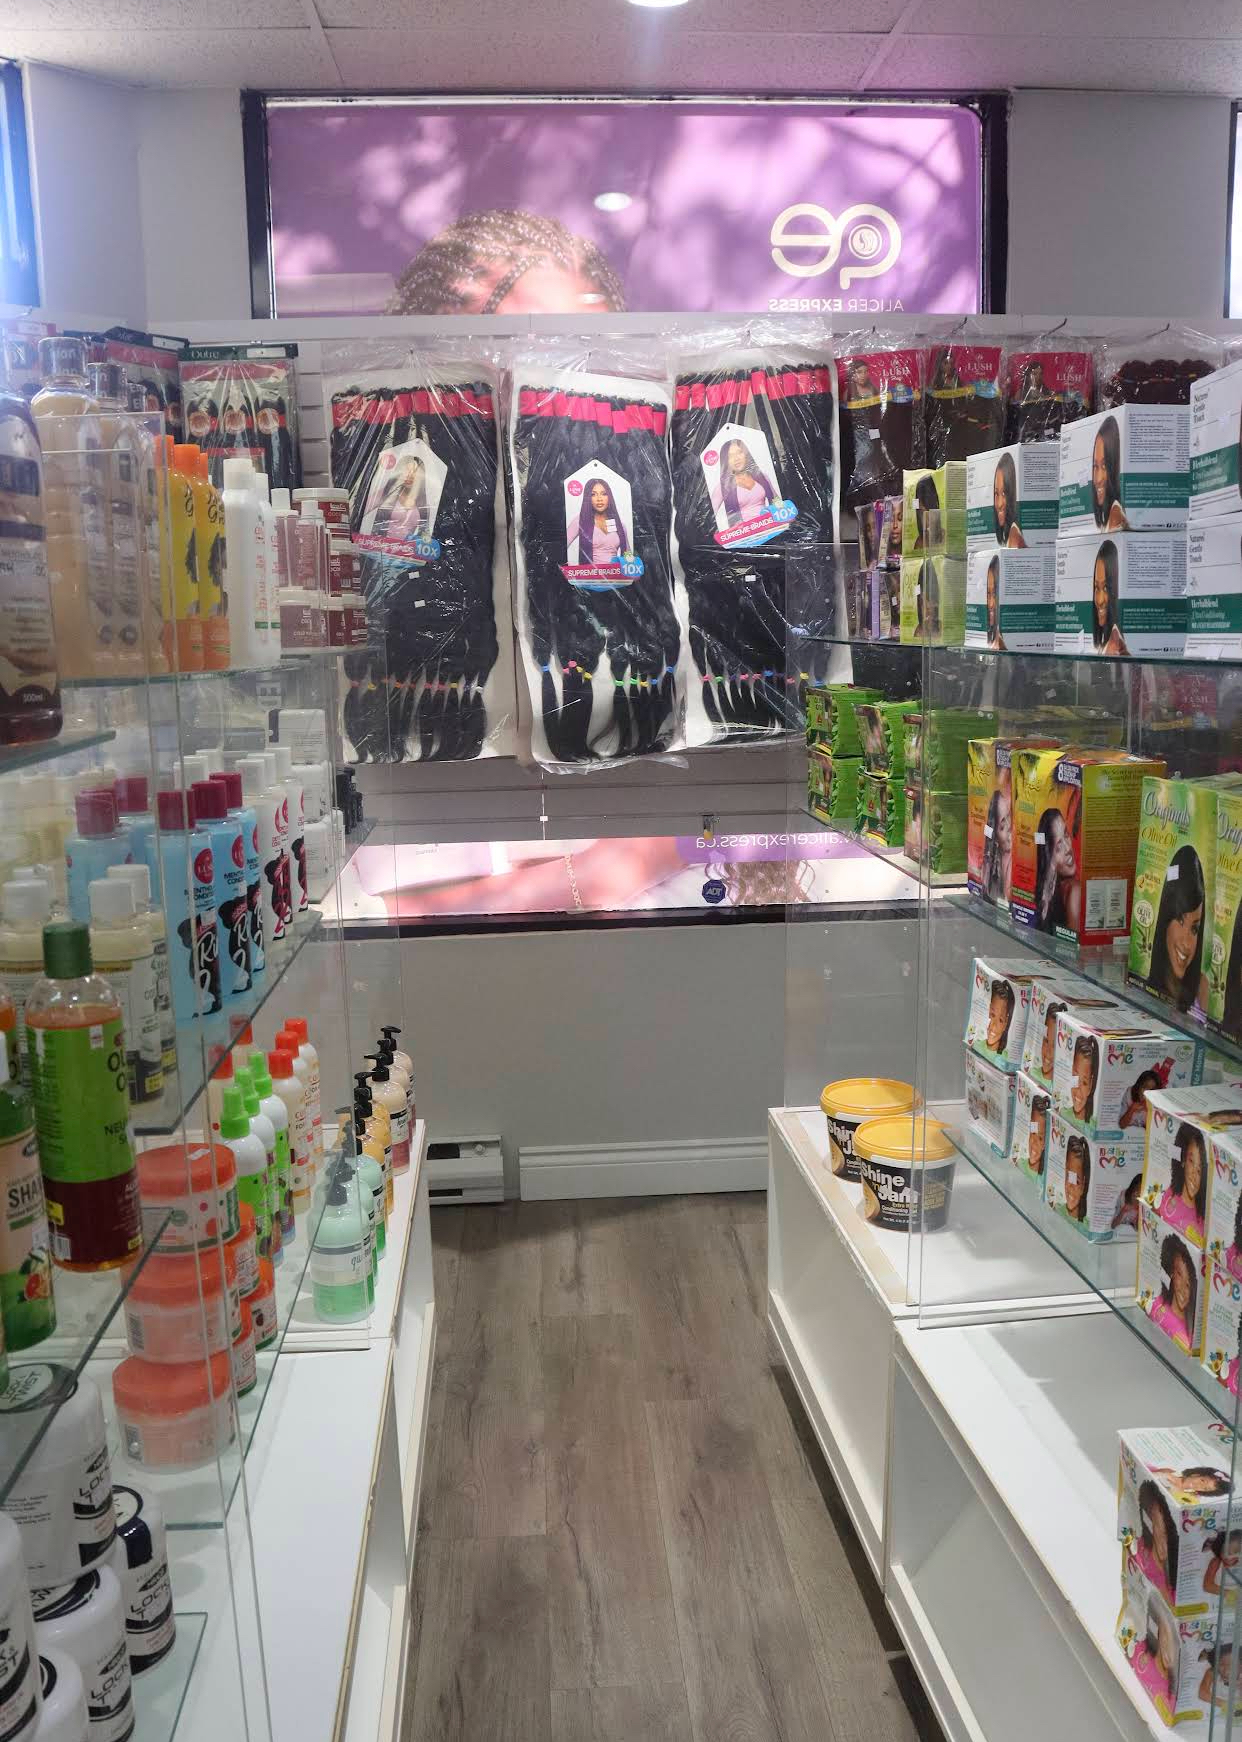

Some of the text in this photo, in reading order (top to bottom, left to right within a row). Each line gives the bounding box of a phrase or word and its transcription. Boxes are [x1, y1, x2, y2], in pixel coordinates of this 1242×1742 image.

[967, 363, 993, 371] LUSH
[720, 528, 749, 542] SUPREME
[568, 568, 599, 577] SUPREME
[706, 887, 722, 896] ADT
[860, 1161, 905, 1187] Shine
